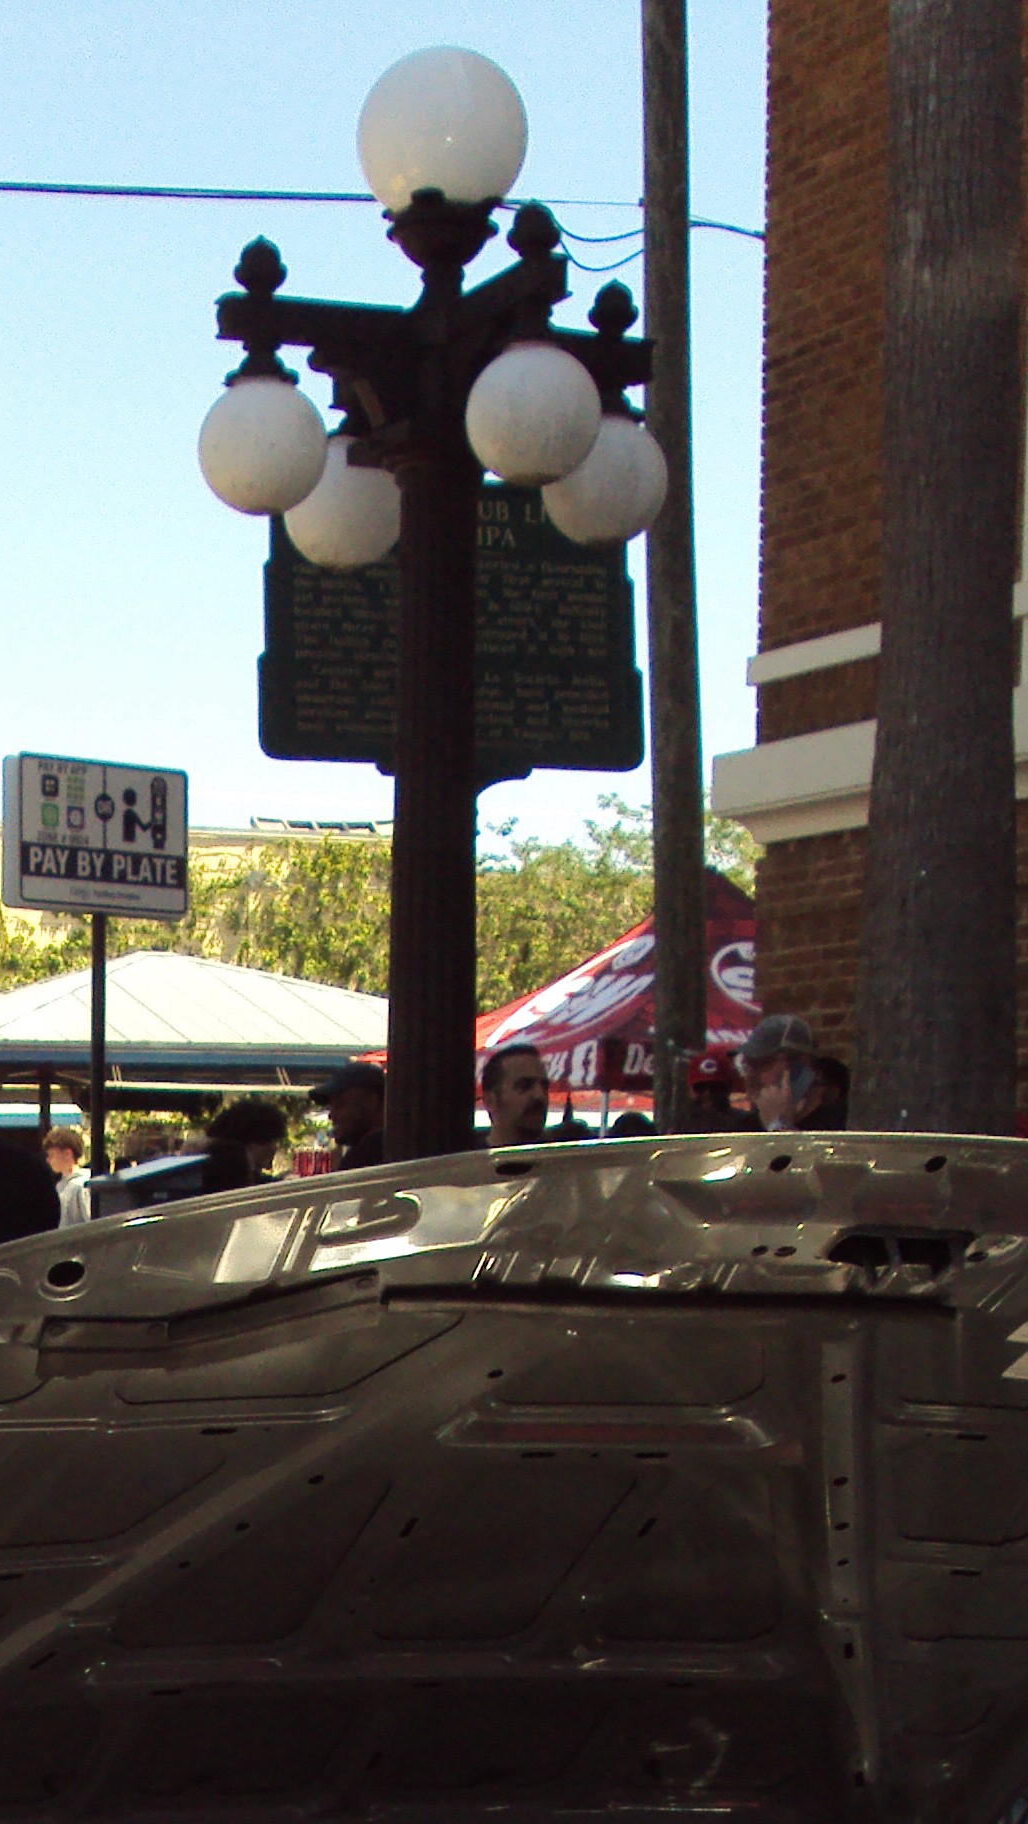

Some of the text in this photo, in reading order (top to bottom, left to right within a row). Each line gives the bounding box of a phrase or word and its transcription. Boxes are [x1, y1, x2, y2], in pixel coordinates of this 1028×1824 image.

[29, 846, 178, 884] PAY BY PLATE
